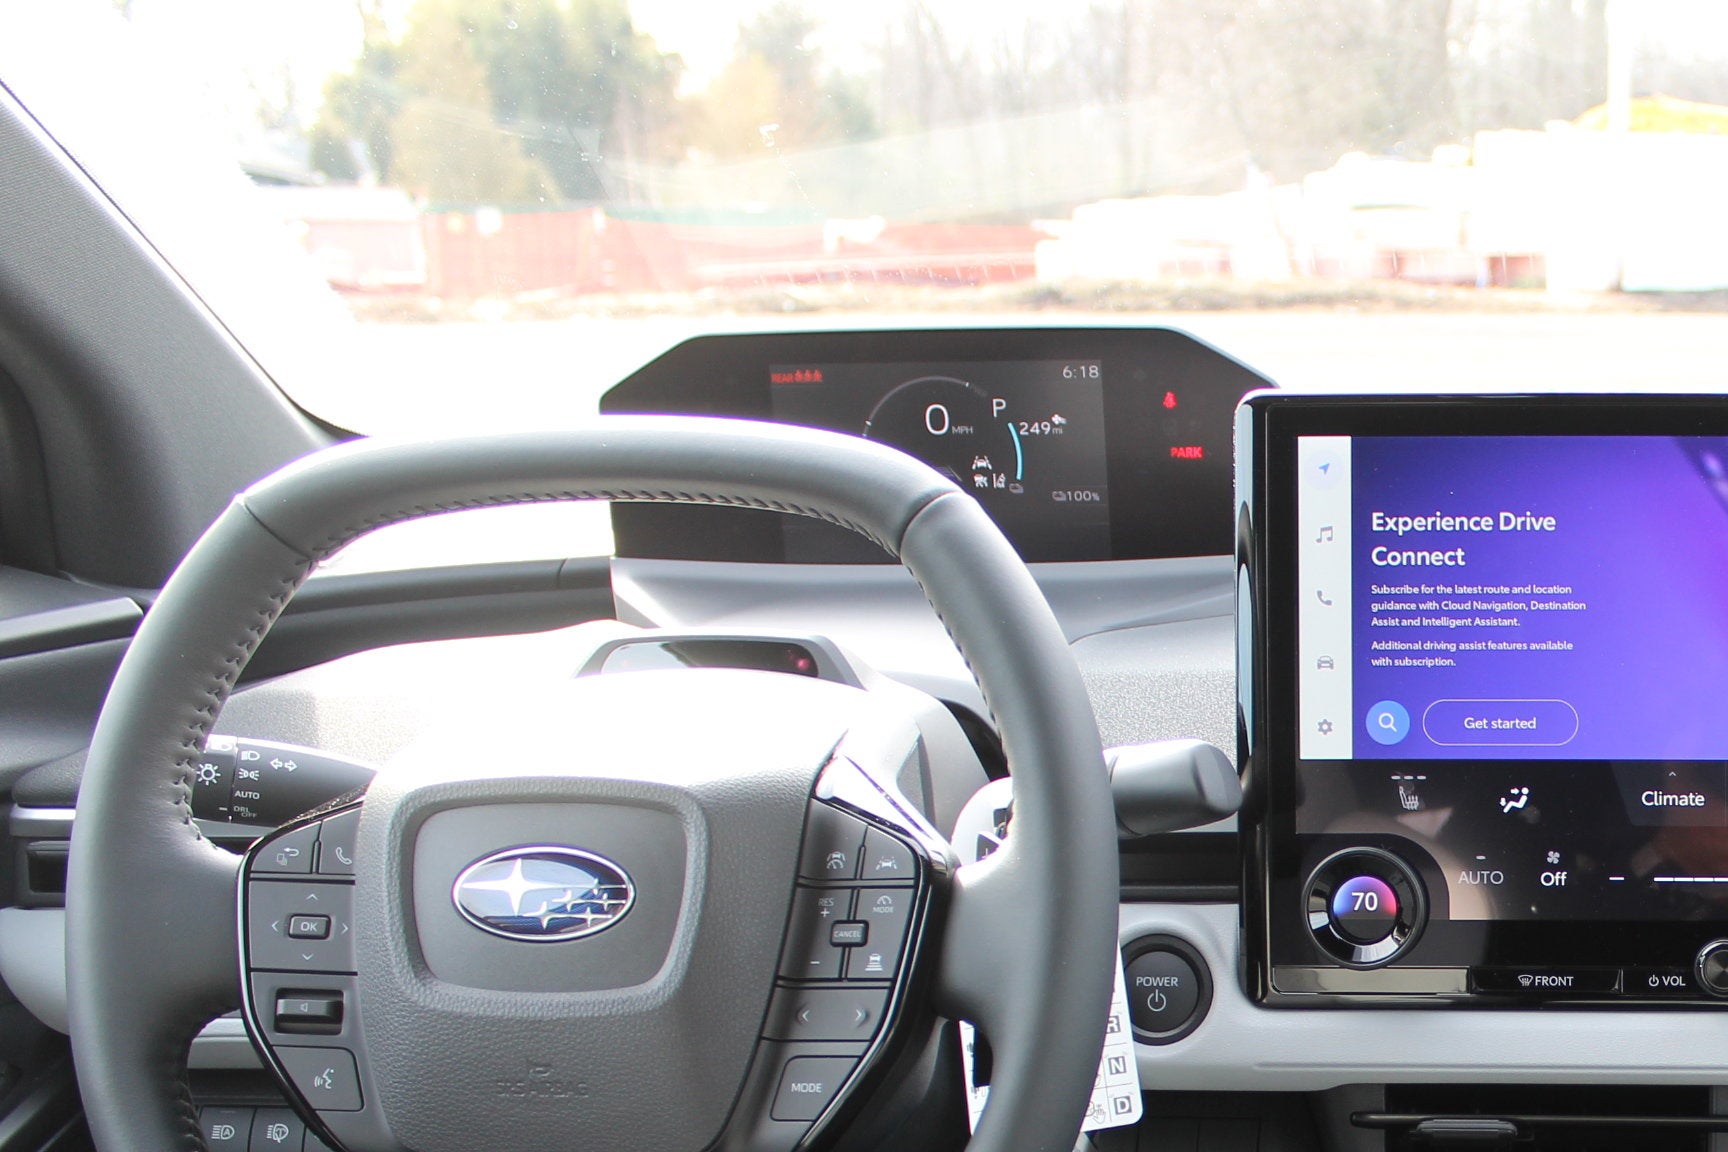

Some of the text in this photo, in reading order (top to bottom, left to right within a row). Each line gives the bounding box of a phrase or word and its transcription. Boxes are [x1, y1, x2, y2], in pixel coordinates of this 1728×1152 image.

[1062, 365, 1099, 379] 6:18
[992, 398, 1006, 418] P
[924, 403, 974, 435] 0 MPH
[1019, 422, 1050, 435] 249
[1170, 447, 1203, 458] PARK
[1067, 491, 1100, 501] 100%
[1371, 511, 1557, 536] Experience Drive
[1371, 546, 1466, 566] Connect
[1371, 584, 1572, 594] Subscribe for the latest route and location
[1371, 600, 1586, 612] guidance with Cloud Navigation, Destination
[1371, 616, 1520, 628] Assist and Intelligent Assistant.
[1371, 640, 1574, 652] Additional driving assist features available
[1371, 656, 1456, 668] with subscription.
[1464, 716, 1537, 730] Get started
[234, 790, 260, 800] AUTO
[1641, 790, 1705, 807] Climate
[1458, 870, 1504, 886] AUTO
[1540, 871, 1567, 887] Off
[818, 897, 834, 907] RES
[1351, 892, 1379, 912] 70
[872, 906, 894, 914] MODE
[300, 921, 318, 932] OK
[834, 929, 861, 939] CANCEL
[1136, 976, 1179, 988] POWER
[1535, 975, 1574, 987] FRONT
[1662, 975, 1686, 987] VOL
[1107, 1017, 1119, 1032] R
[1112, 1058, 1125, 1074] N
[791, 1082, 822, 1094] MODE
[1116, 1097, 1130, 1114] D
